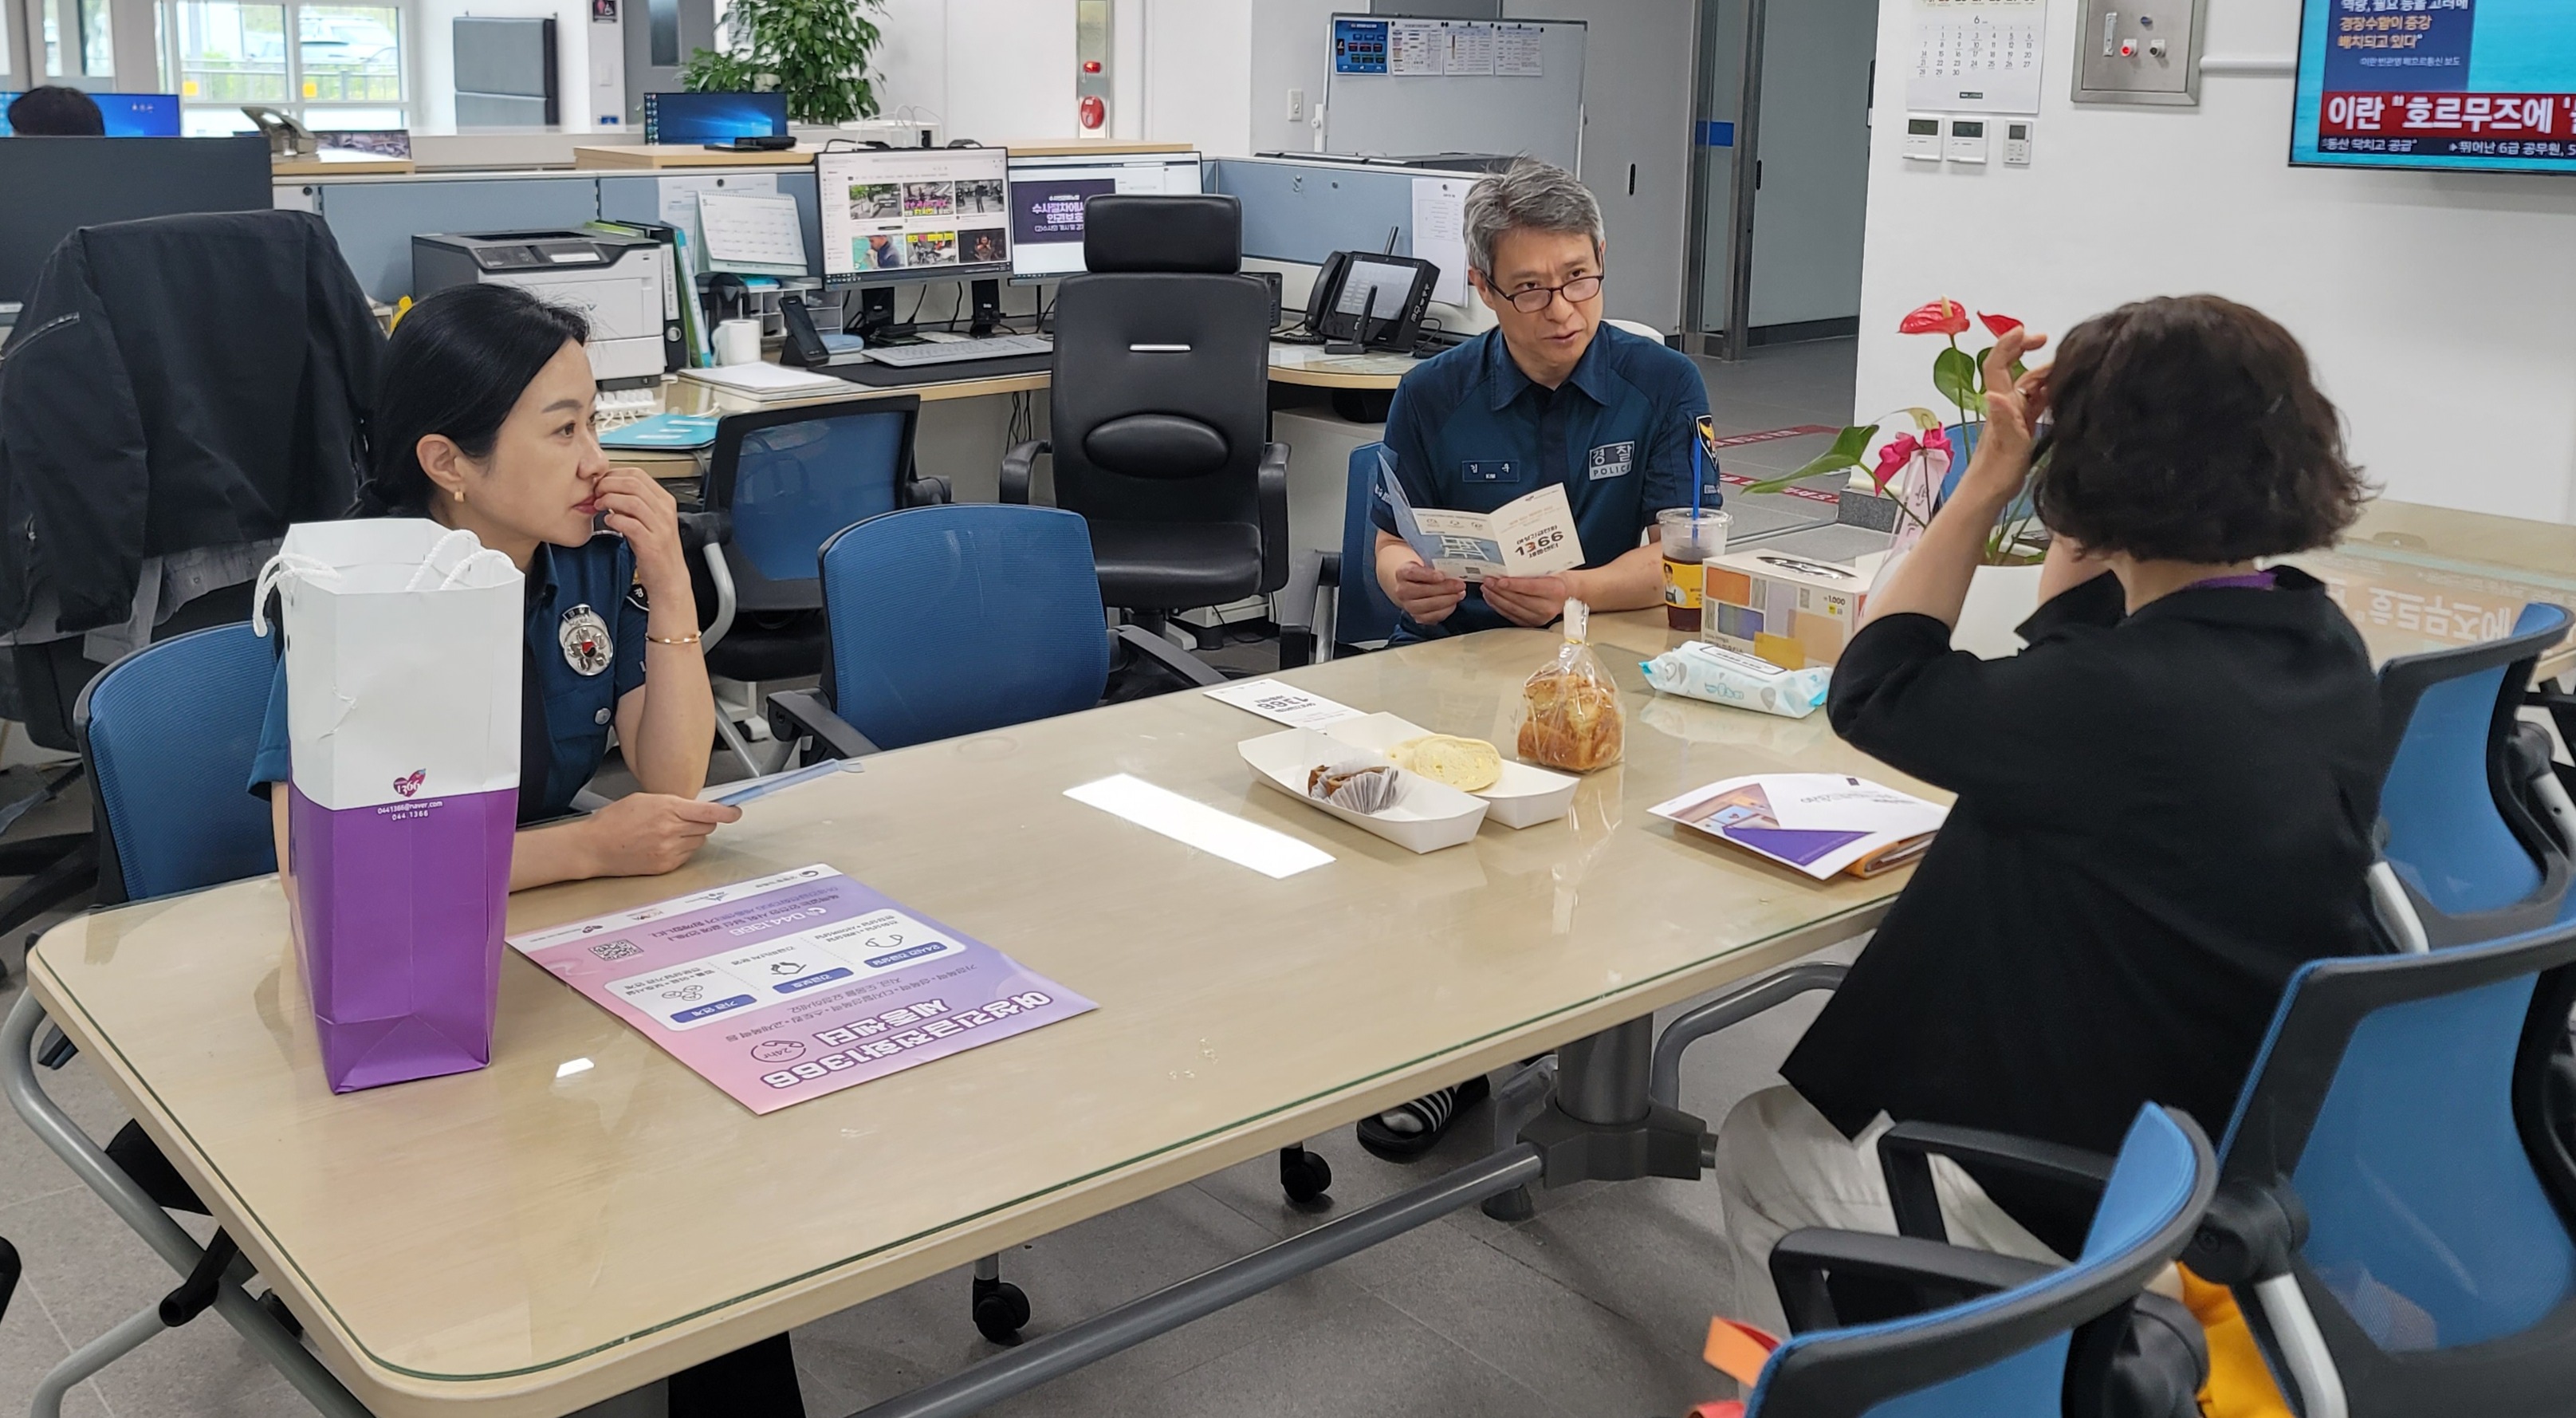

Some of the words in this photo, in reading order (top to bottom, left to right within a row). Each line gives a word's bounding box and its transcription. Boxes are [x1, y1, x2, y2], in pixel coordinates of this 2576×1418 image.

[2405, 15, 2432, 31] 증강
[2338, 34, 2389, 49] 배치되고
[2328, 96, 2385, 130] 이란
[2392, 95, 2554, 134] "호르무즈에
[2499, 142, 2521, 155] 6급
[1515, 531, 1563, 556] 1366
[397, 779, 421, 795] 1366
[713, 1000, 738, 1009] 기관
[810, 997, 957, 1047] 세종센터
[758, 1046, 793, 1060] 24hr
